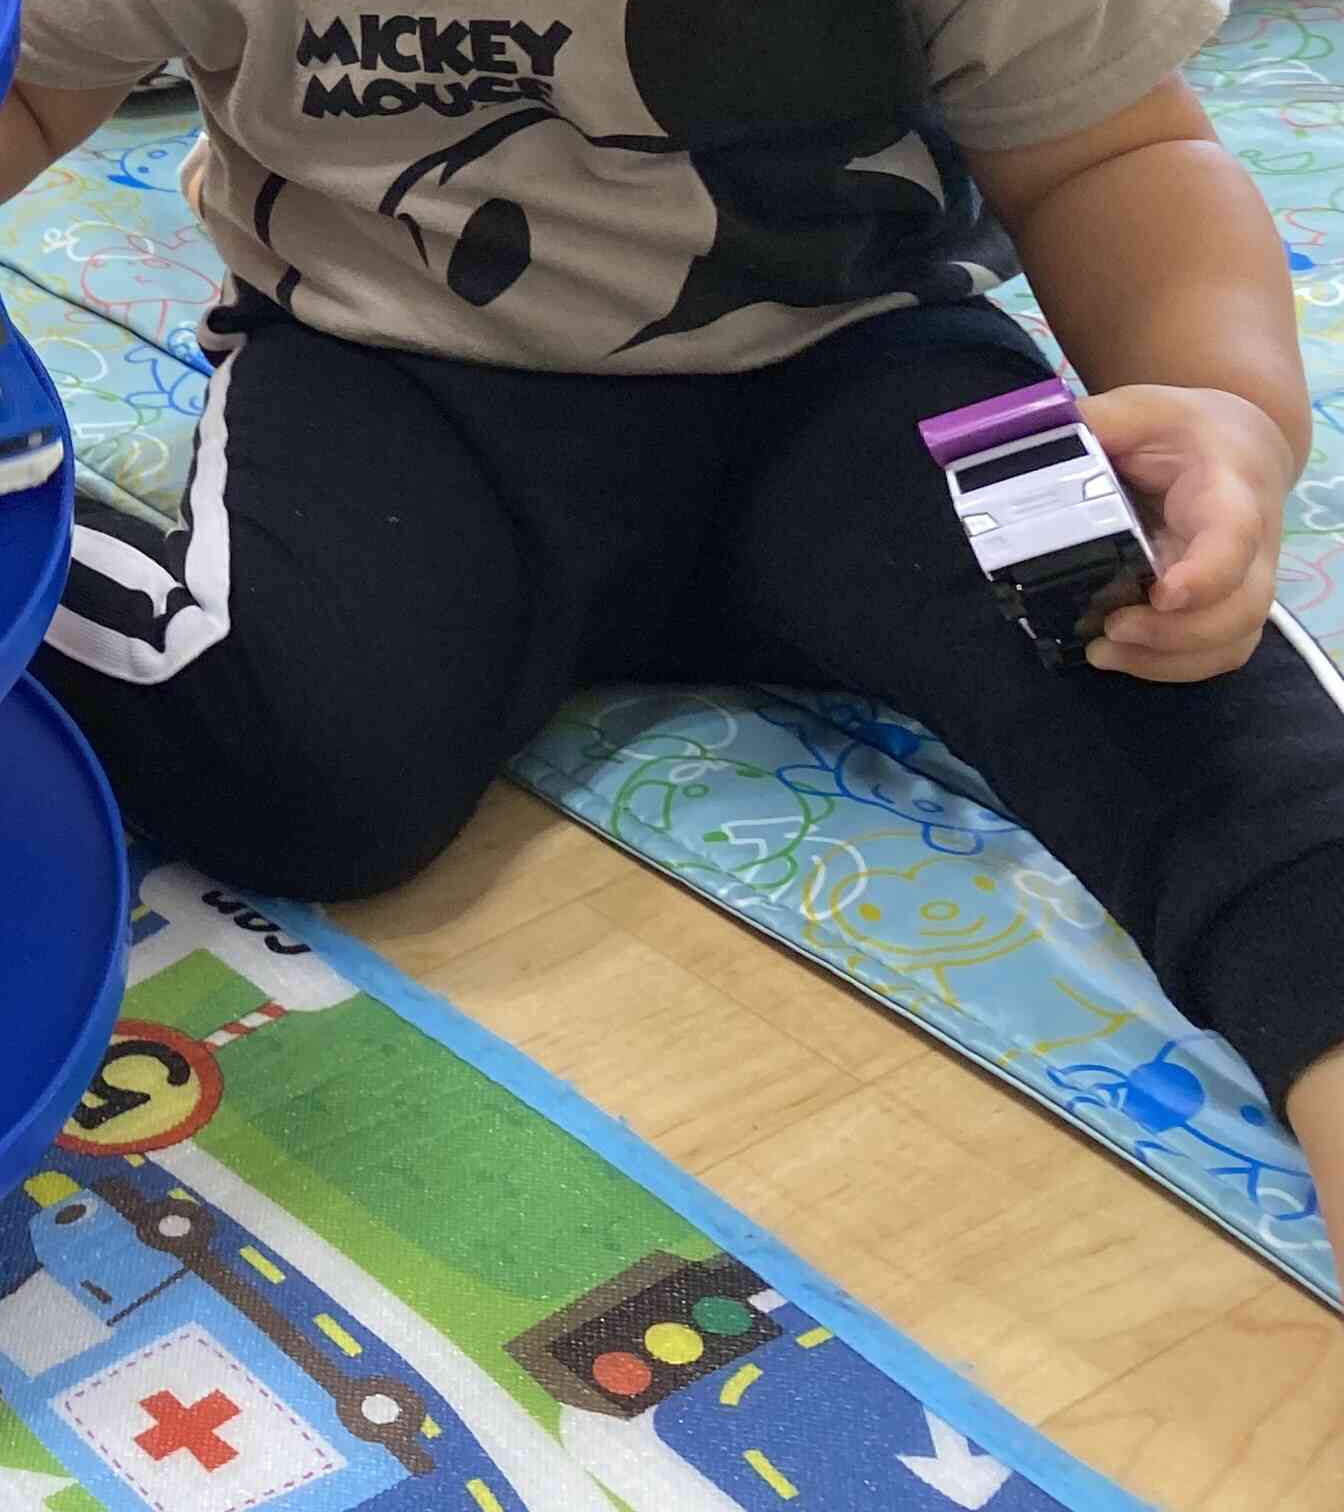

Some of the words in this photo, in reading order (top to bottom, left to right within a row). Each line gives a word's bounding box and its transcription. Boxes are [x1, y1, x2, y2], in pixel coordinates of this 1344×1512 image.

[296, 15, 573, 76] MICKEY
[302, 74, 555, 119] MOUSE
[70, 1039, 192, 1130] 5
